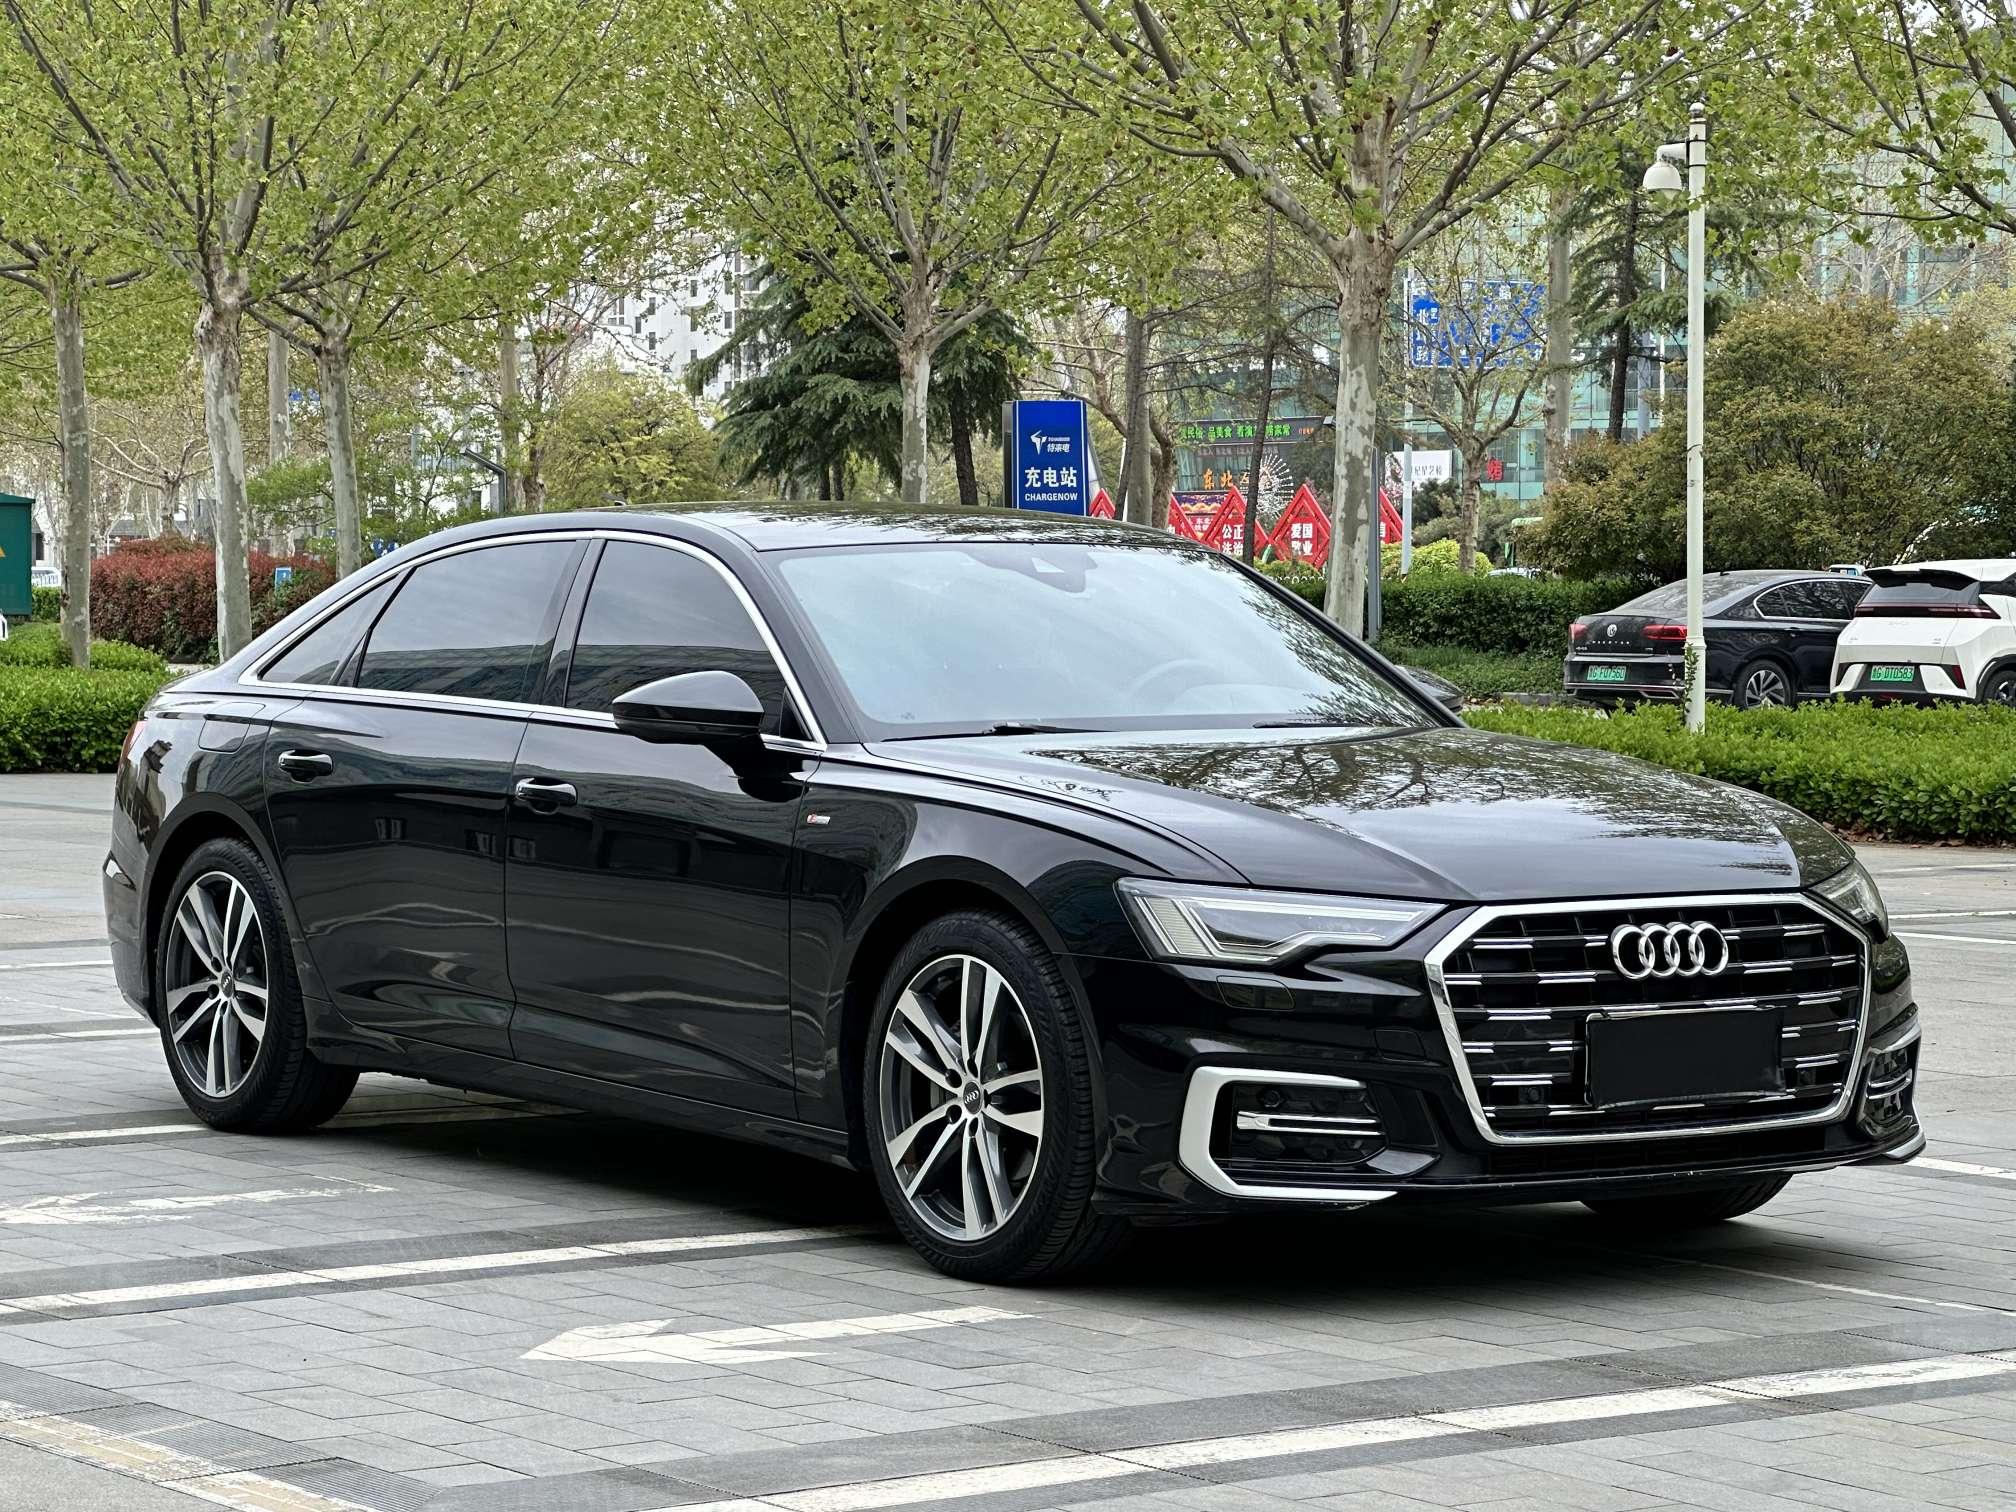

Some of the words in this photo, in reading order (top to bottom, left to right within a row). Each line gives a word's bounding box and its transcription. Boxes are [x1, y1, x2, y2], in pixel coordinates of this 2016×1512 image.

[1024, 466, 1077, 487] 充电站
[1024, 492, 1077, 501] CHARGENOW
[1222, 523, 1243, 539] 公正
[1291, 522, 1312, 539] 爱国
[1222, 541, 1243, 556] 法治
